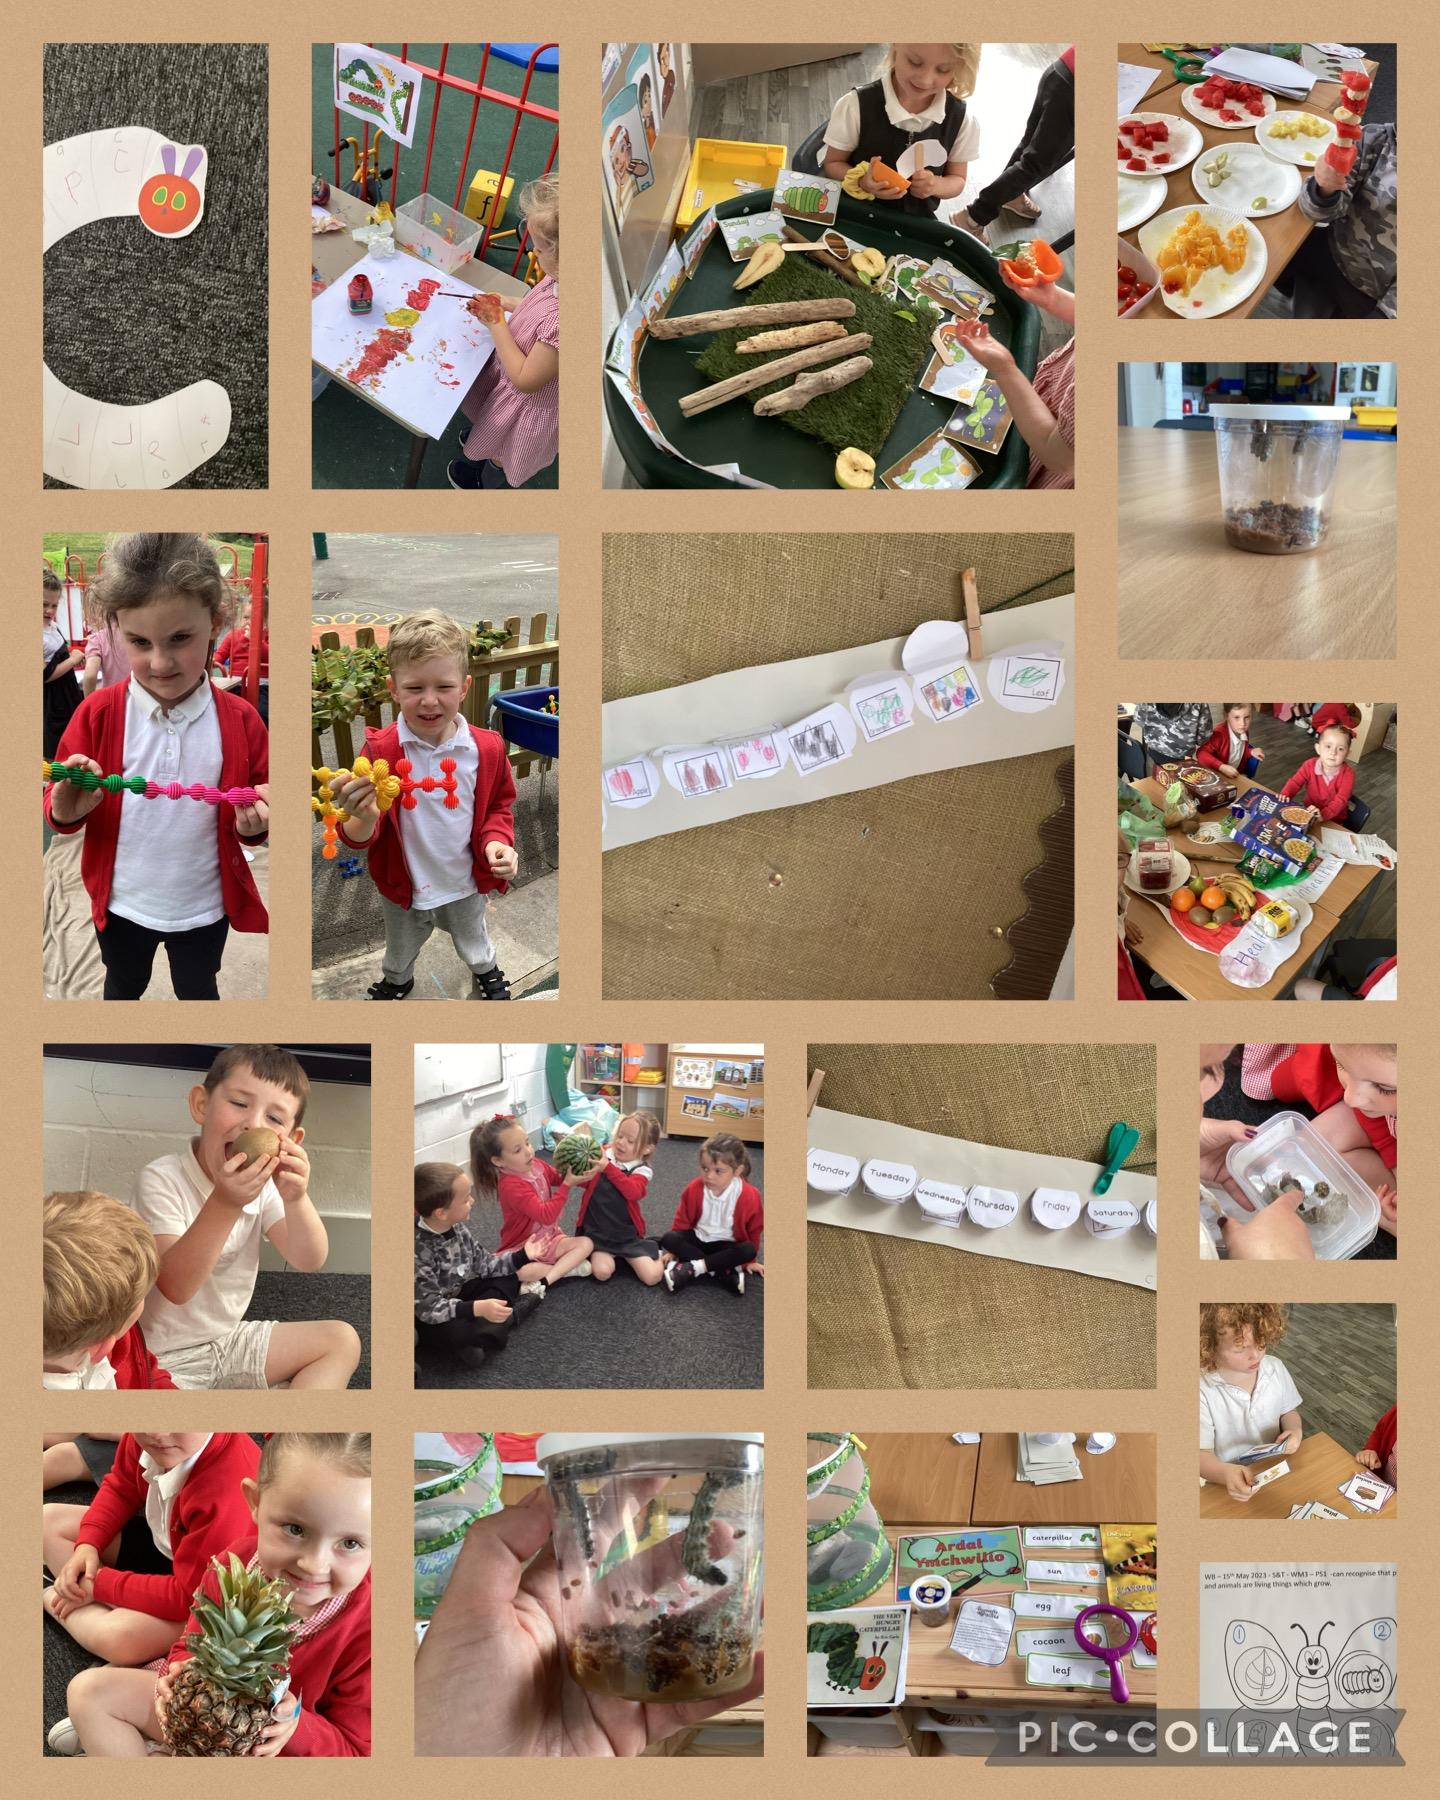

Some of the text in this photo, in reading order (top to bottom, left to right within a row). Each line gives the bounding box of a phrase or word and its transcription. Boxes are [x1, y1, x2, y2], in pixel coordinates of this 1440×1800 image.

[476, 195, 494, 220] f
[722, 218, 750, 228] Sunday
[611, 338, 625, 366] Friday
[812, 1162, 850, 1178] Monday
[870, 1168, 910, 1184] Tuesday
[917, 1188, 967, 1207] Wednesday
[974, 1198, 1015, 1213] Thursday
[1042, 1200, 1071, 1213] Friday
[1092, 1209, 1134, 1217] Saturday
[935, 1538, 983, 1553] Ardal
[914, 1551, 1005, 1569] Ymchwilio
[1235, 1573, 1249, 1581] May
[1345, 1570, 1377, 1578] recognise
[1254, 1581, 1272, 1589] living
[1273, 1580, 1292, 1588] things
[1035, 1604, 1052, 1612] egg
[1032, 1638, 1066, 1646] cocoon
[1052, 1665, 1072, 1677] leaf
